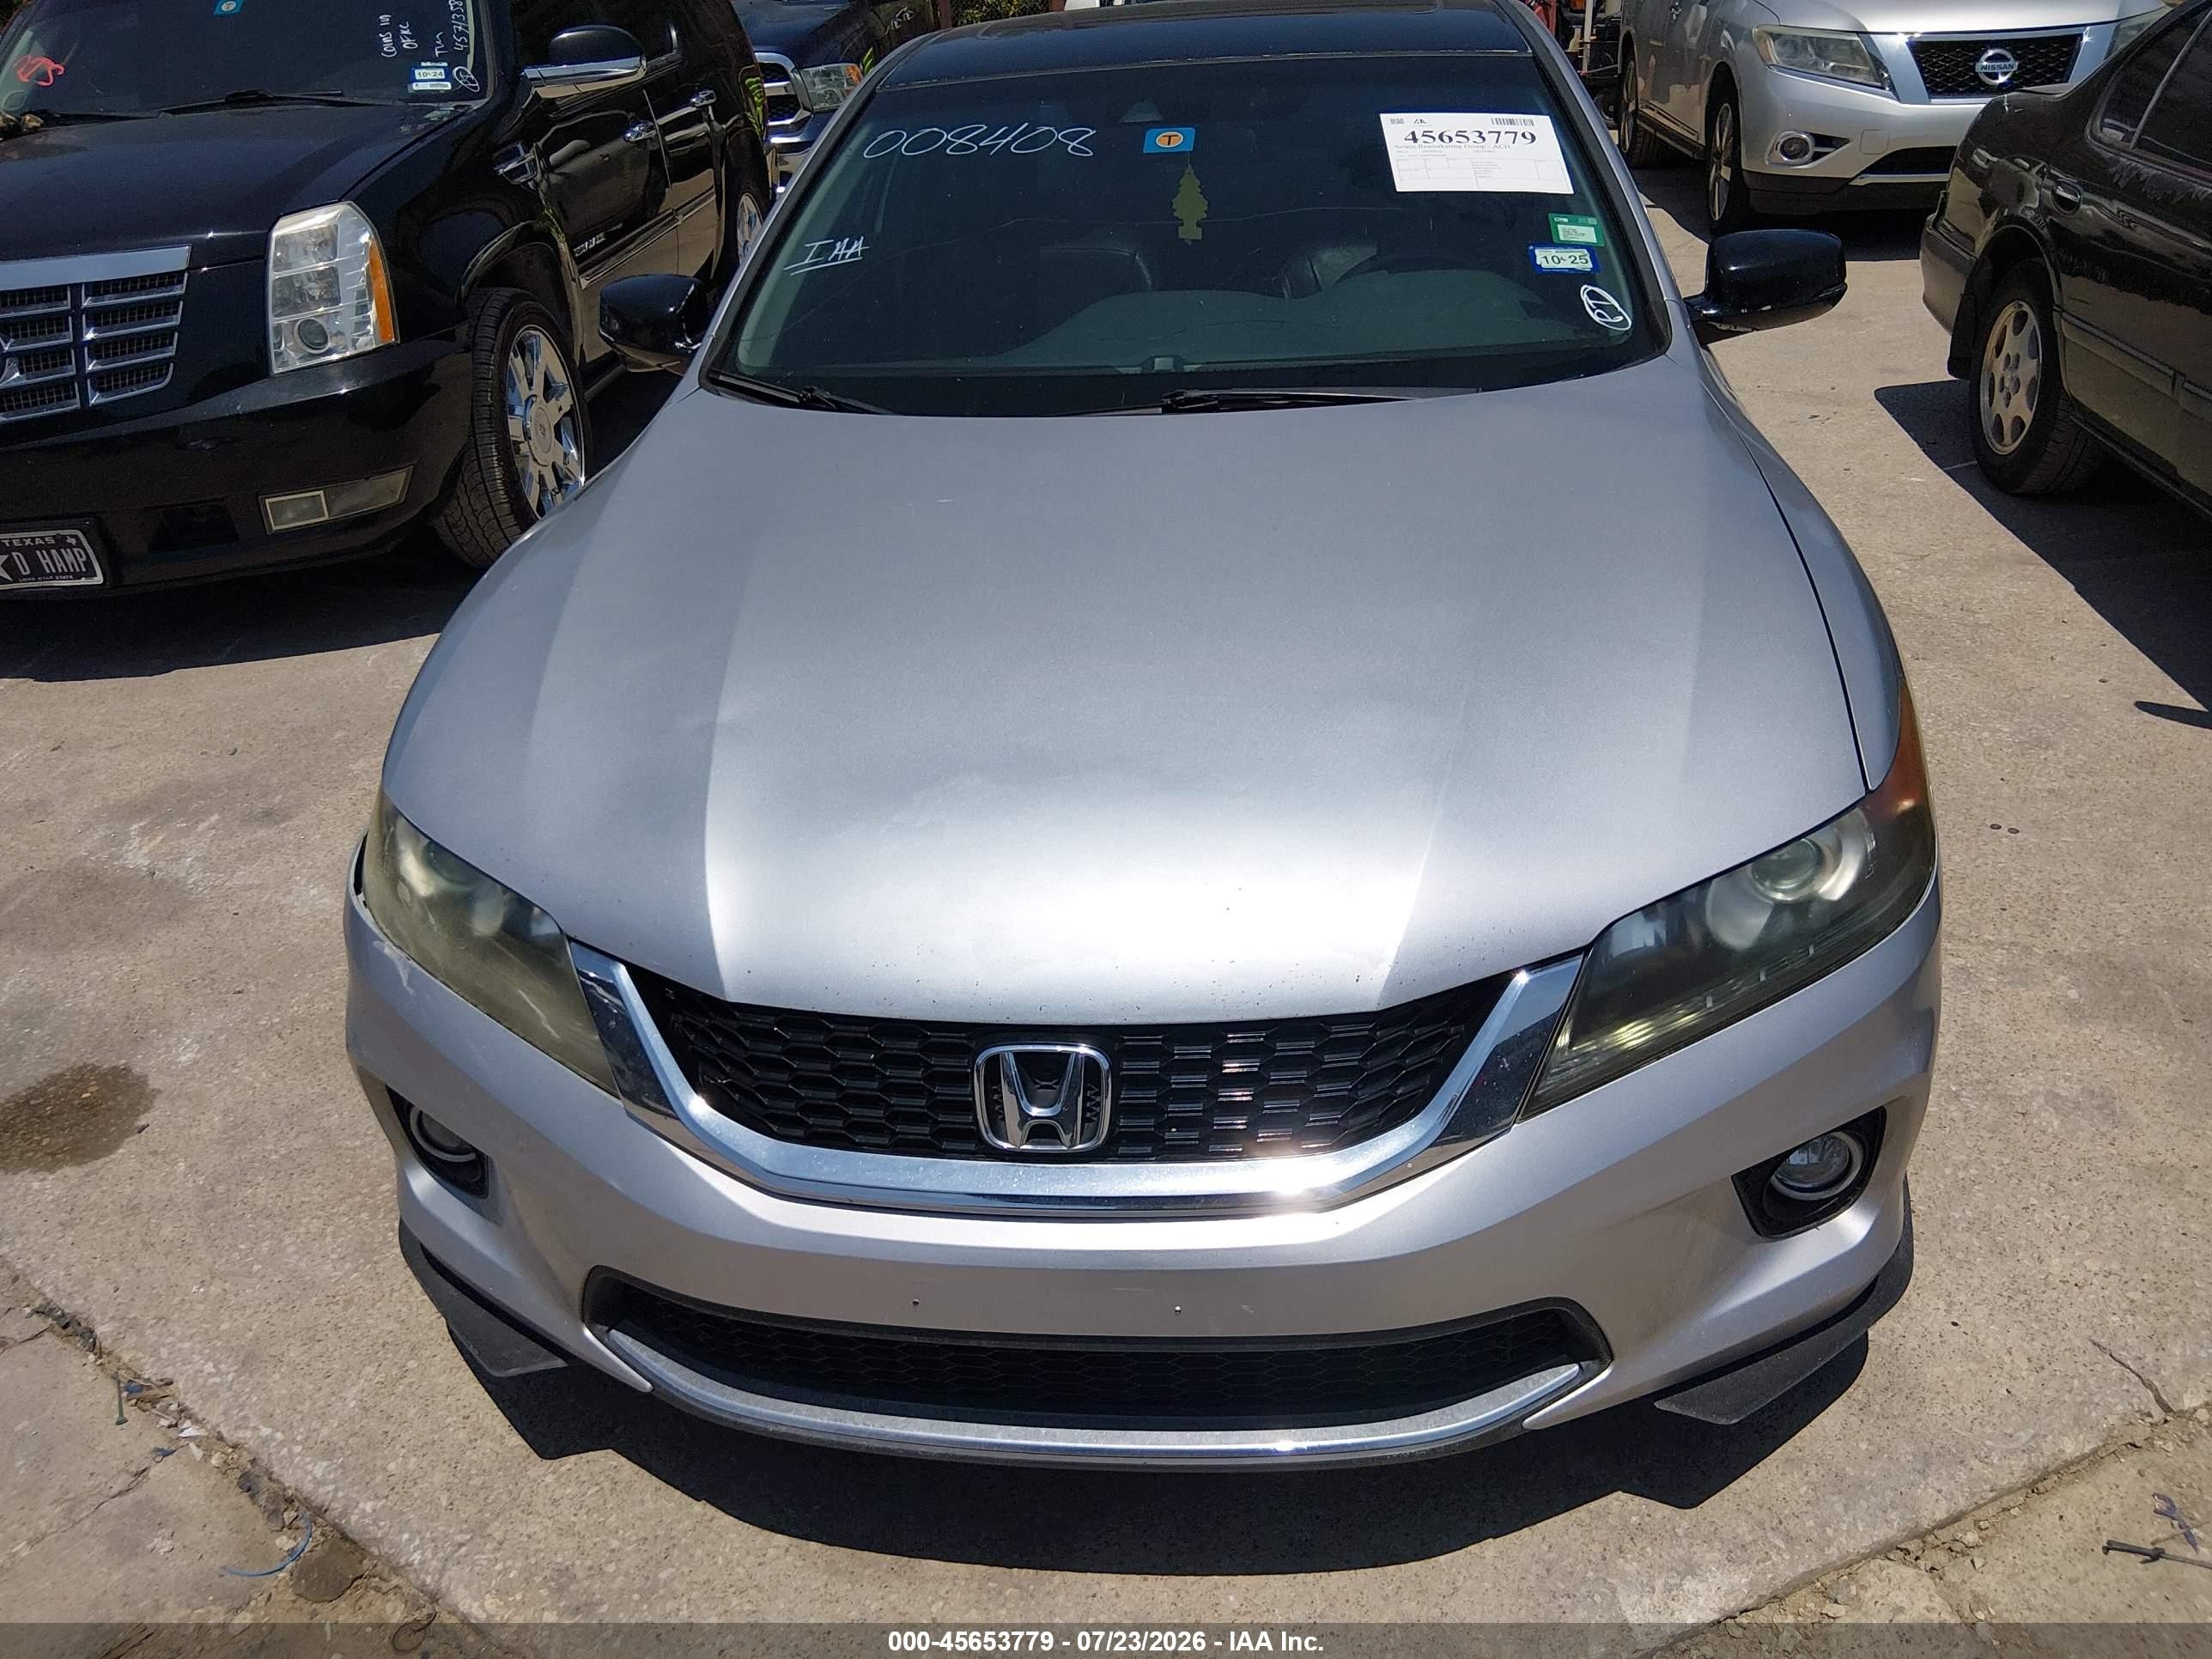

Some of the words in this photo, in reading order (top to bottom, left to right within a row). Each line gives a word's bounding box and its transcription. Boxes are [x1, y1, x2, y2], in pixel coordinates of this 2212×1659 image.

[863, 122, 1097, 159] 008408
[1162, 133, 1180, 146] T
[1403, 129, 1537, 145] 45653779
[1, 536, 56, 547] TEXAS
[35, 548, 87, 574] HAMP
